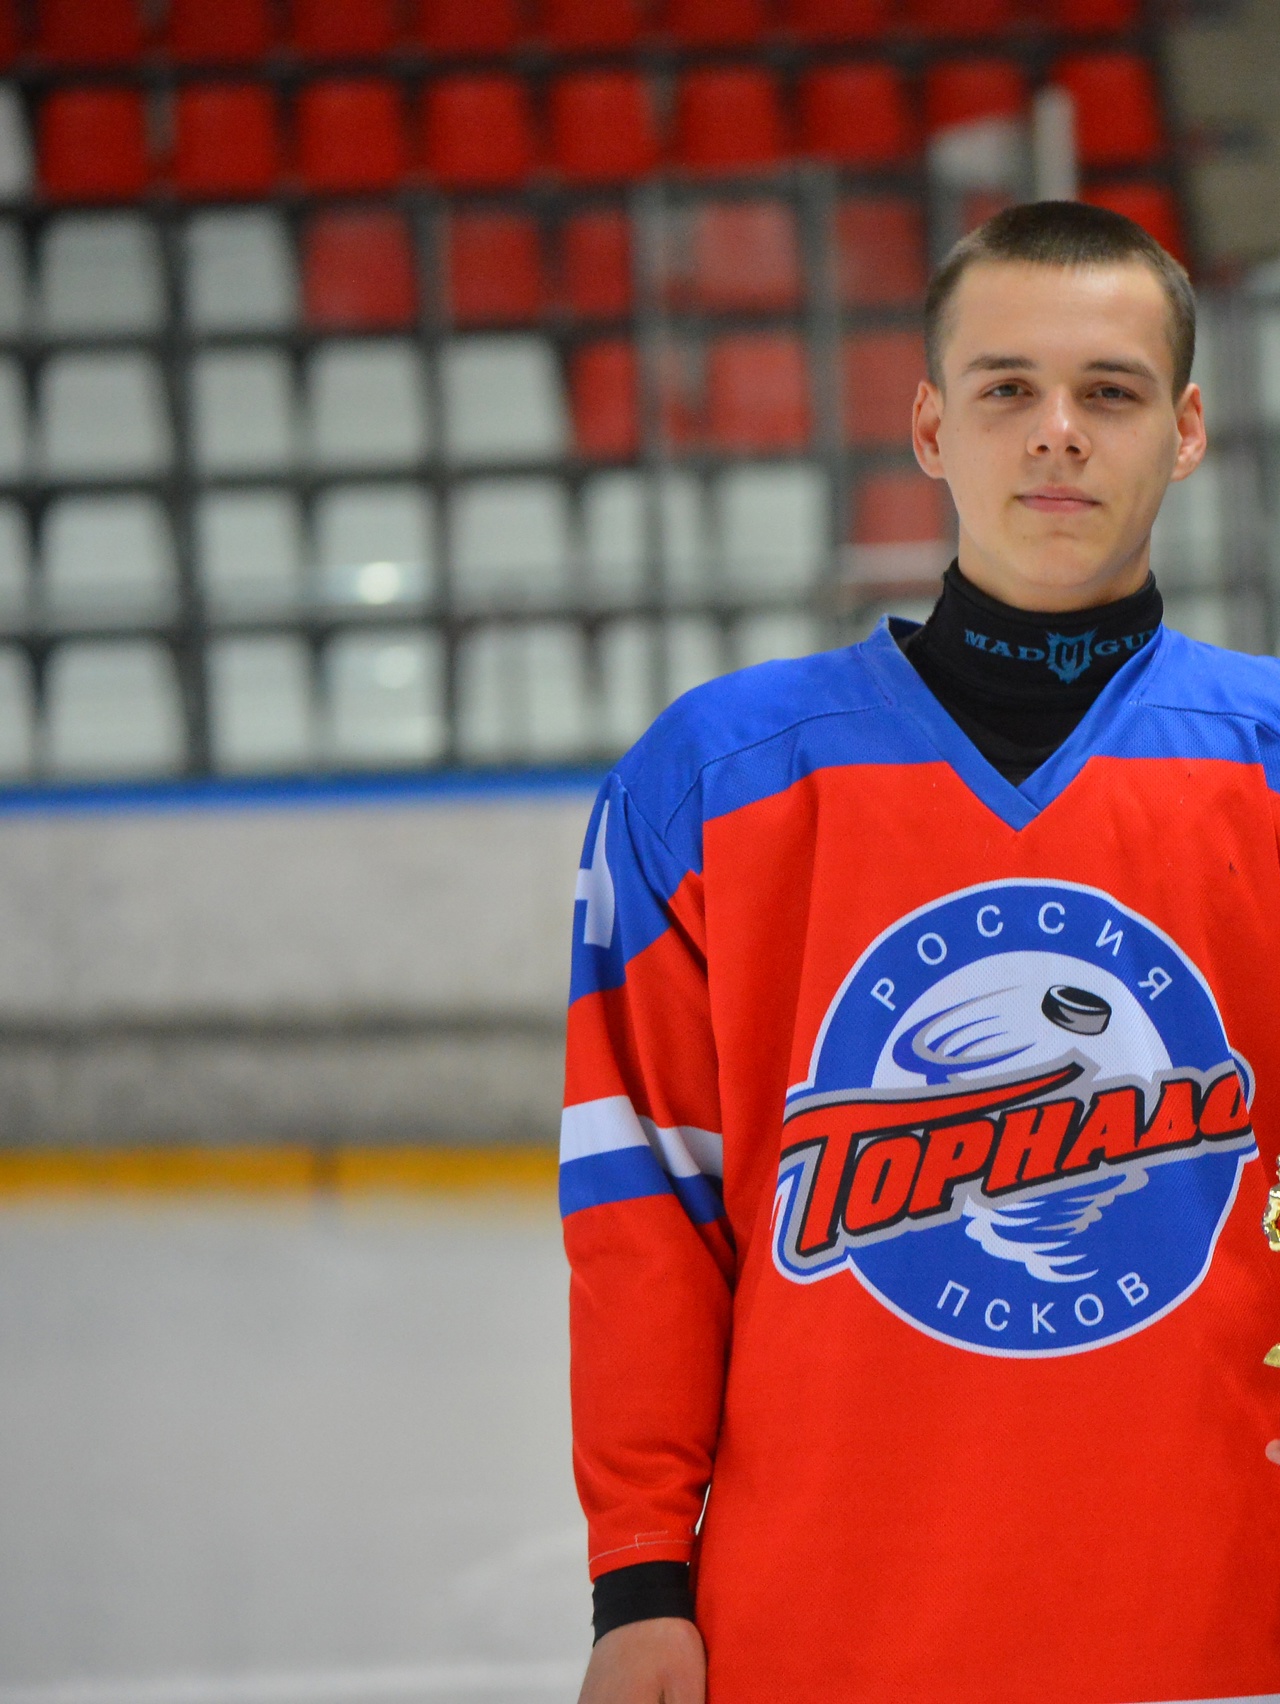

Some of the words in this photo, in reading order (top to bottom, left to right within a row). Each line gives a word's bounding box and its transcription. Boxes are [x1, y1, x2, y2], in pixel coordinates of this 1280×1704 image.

[964, 629, 1046, 662] MAD
[1094, 629, 1155, 656] GU
[870, 901, 1173, 1011] РОССИЯ
[936, 1271, 1150, 1335] ПСКОВ
